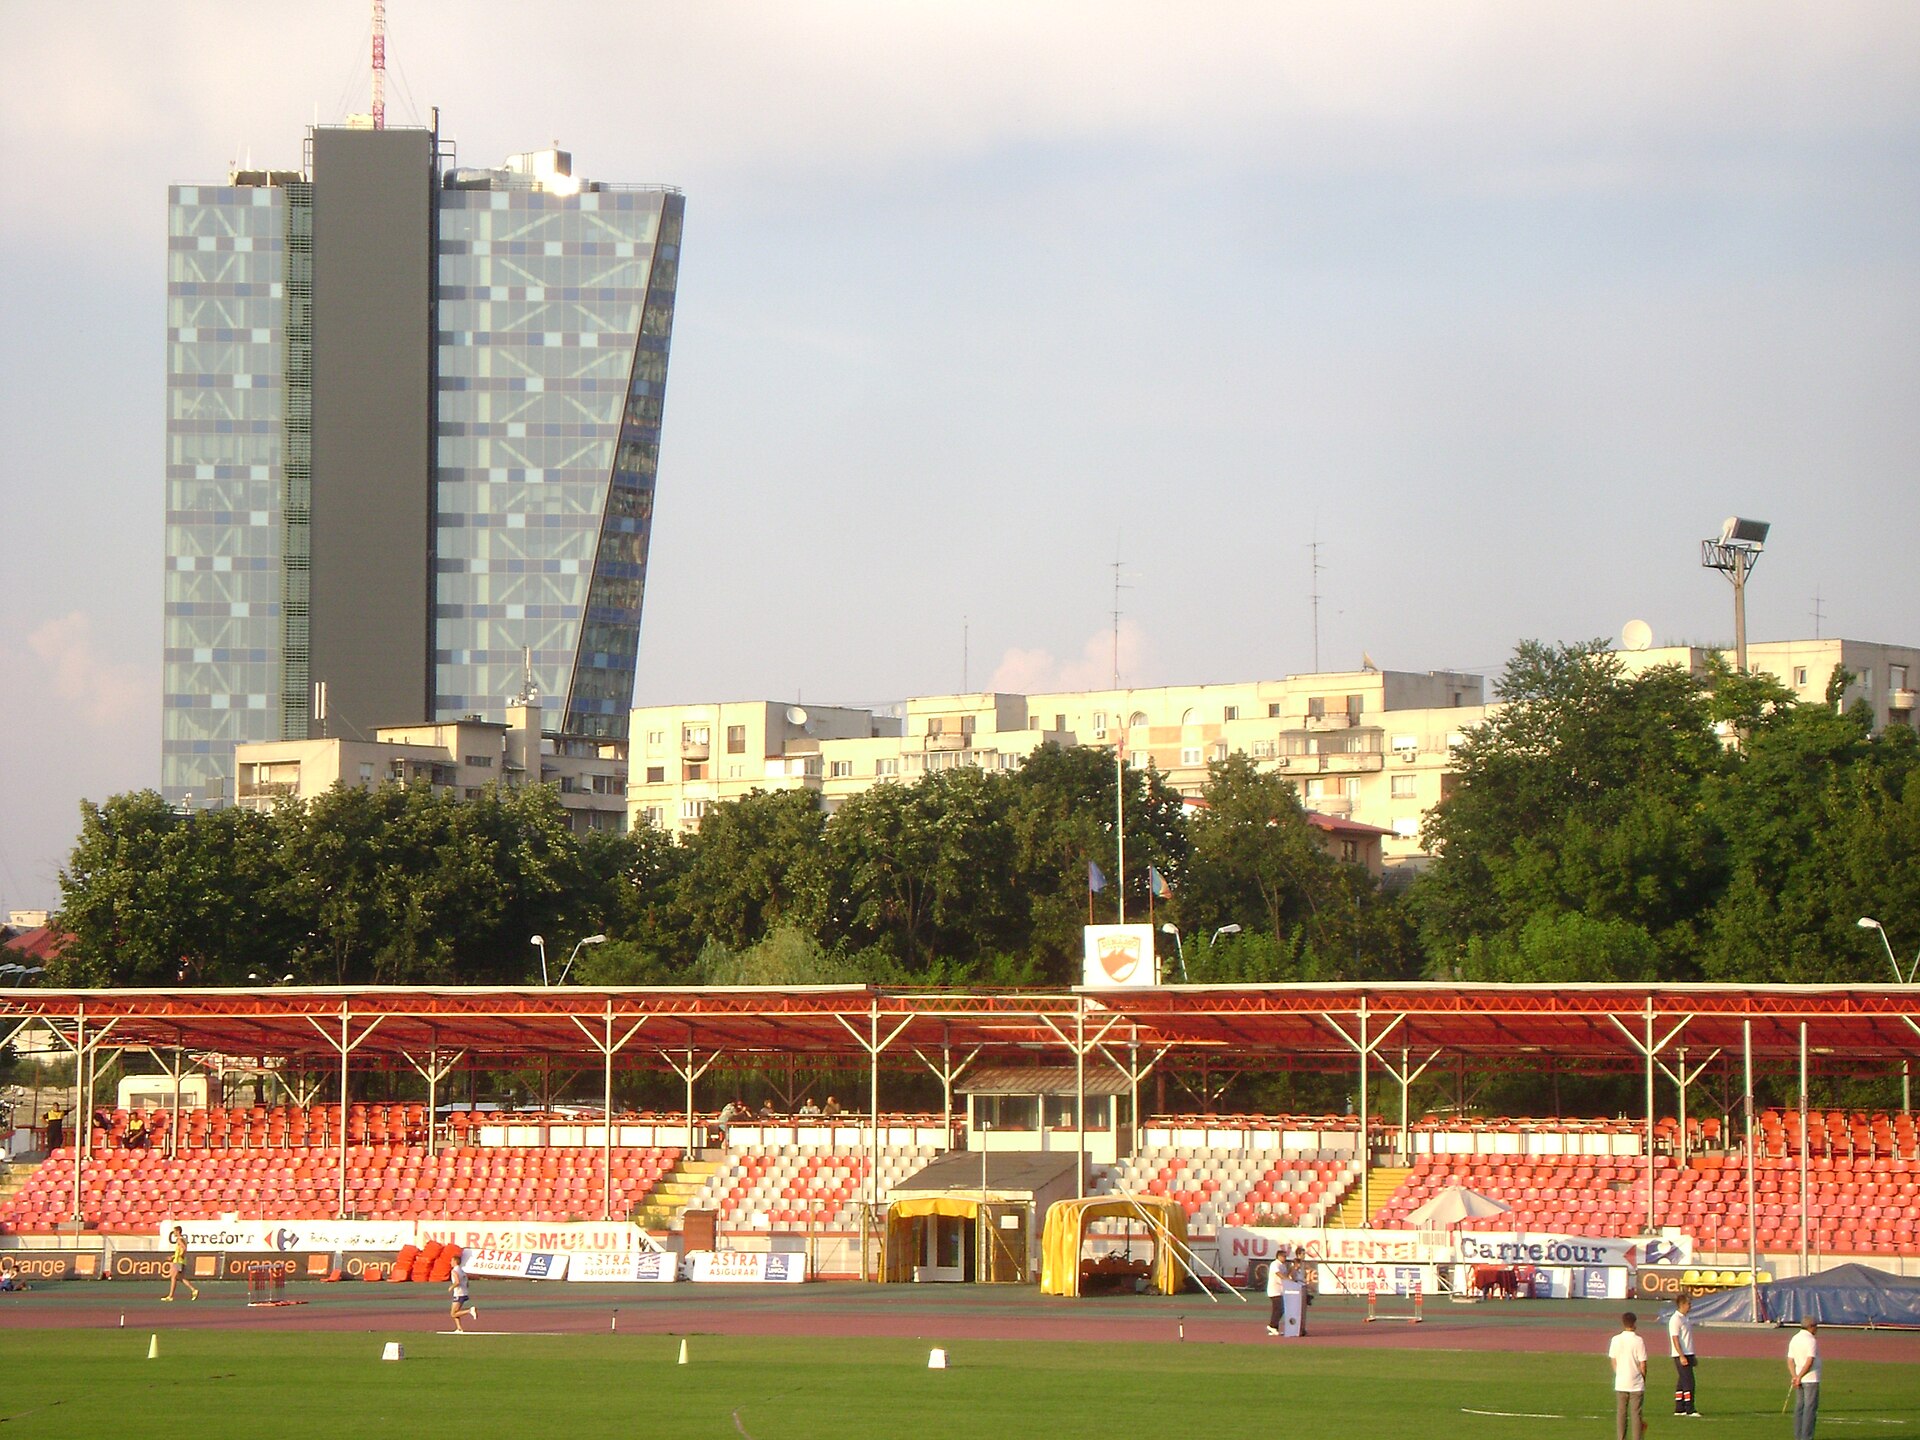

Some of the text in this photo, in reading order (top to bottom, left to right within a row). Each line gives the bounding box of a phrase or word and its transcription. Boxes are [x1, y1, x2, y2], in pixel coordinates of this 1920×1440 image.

[1232, 1238, 1269, 1257] NU
[1461, 1236, 1608, 1265] Carrefour
[476, 1249, 523, 1264] ASTRA
[710, 1253, 759, 1266] ASTRA
[116, 1257, 173, 1278] Orang
[1336, 1266, 1387, 1280] ASTRA
